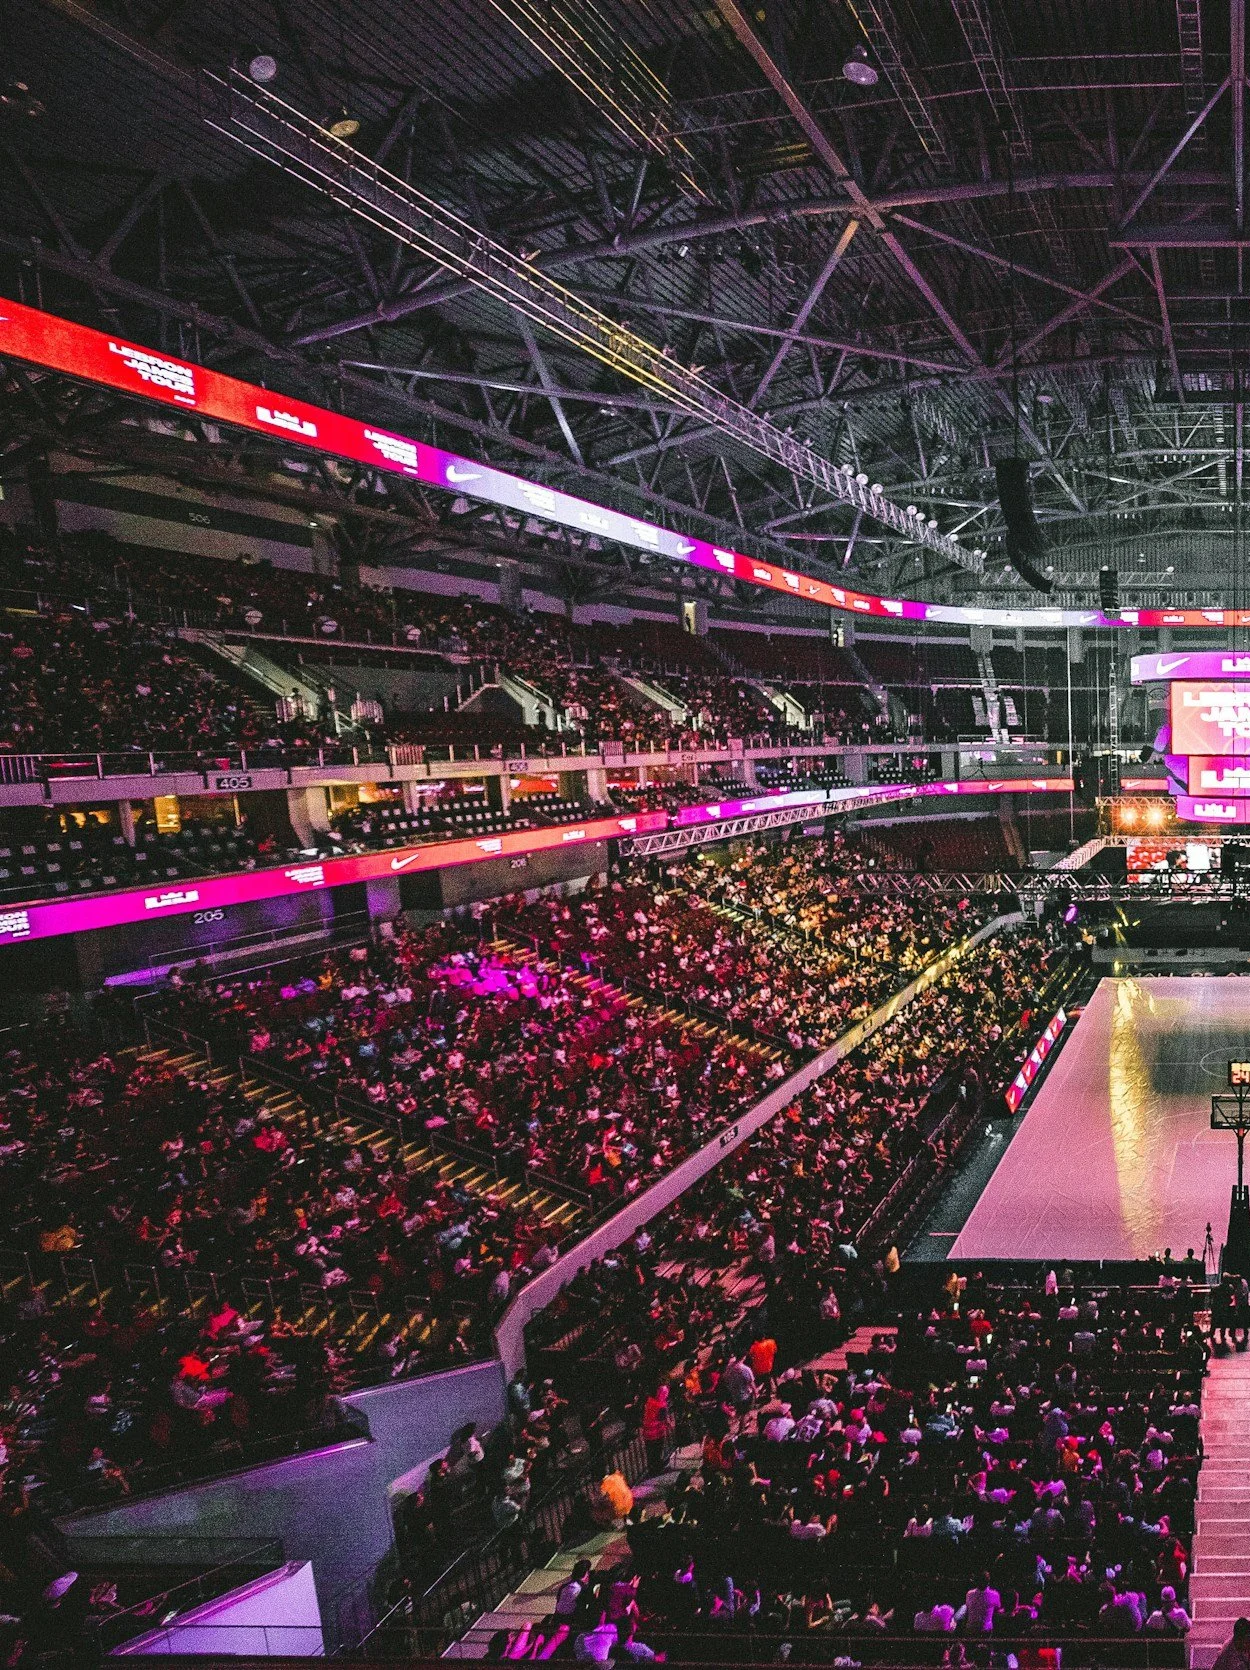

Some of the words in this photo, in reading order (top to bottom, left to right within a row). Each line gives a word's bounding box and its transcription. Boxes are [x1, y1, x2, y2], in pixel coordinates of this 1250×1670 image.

[108, 341, 193, 378] LEBRON
[137, 369, 195, 395] TOUR
[220, 777, 249, 788] 405
[193, 909, 224, 924] 205
[1232, 1071, 1250, 1084] 24
